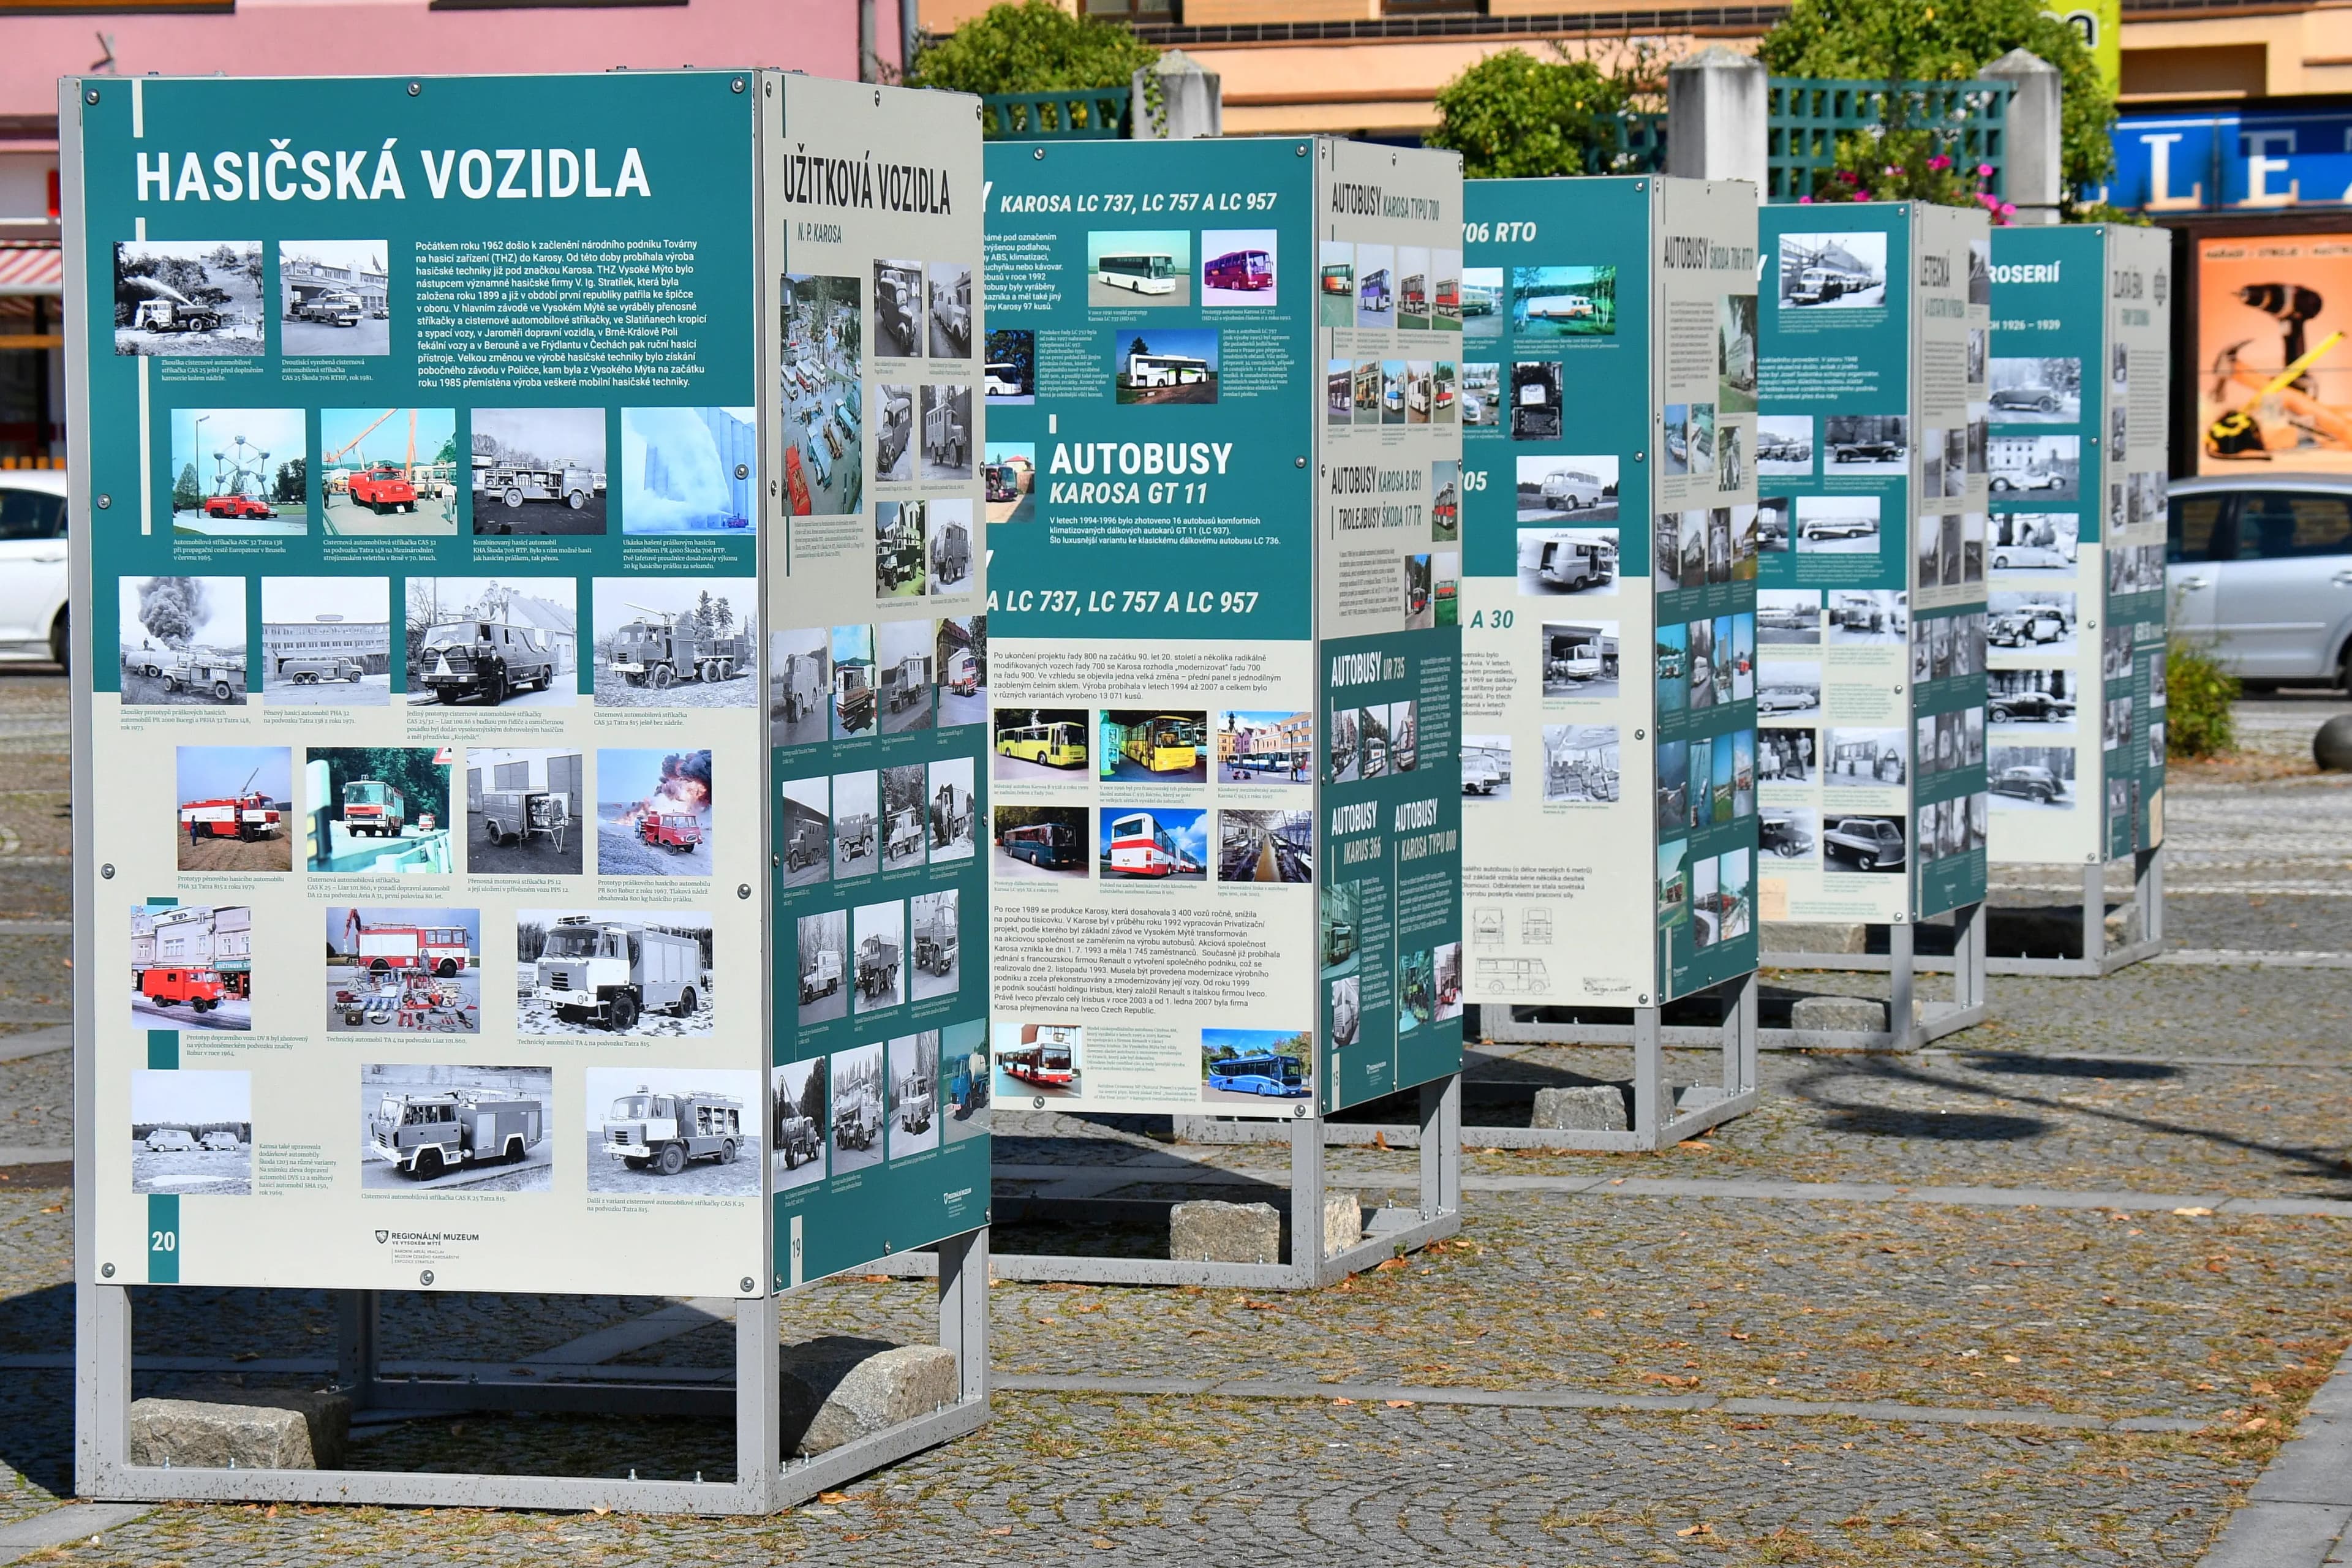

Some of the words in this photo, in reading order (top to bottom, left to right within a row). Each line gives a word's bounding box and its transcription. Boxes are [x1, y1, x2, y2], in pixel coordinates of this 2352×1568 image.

[137, 138, 406, 201] HASIČSKÁ
[420, 148, 651, 199] VOZIDLA
[783, 143, 873, 209] UŽITKOVÁ
[877, 163, 951, 215] VOZIDLA
[1000, 195, 1071, 213] KAROSA
[1077, 194, 1099, 212] LC
[1103, 194, 1137, 215] 737,
[1142, 194, 1164, 211] LC
[1169, 193, 1199, 211] 757
[1202, 193, 1215, 211] A
[1219, 192, 1242, 211] LC
[1246, 192, 1277, 210] 957
[1332, 182, 1382, 216] AUTOBUSY
[1382, 195, 1409, 219] KAROSA
[1411, 197, 1428, 221] TYPU
[1428, 199, 1439, 221] 700
[797, 222, 805, 241] N.
[807, 222, 812, 242] P.
[813, 223, 842, 244] KAROSA
[1463, 222, 1489, 243] 06
[1494, 221, 1537, 242] RTO
[415, 241, 459, 251] Počátkem
[461, 241, 480, 251] roku
[482, 241, 504, 250] 1962
[505, 240, 530, 250] došlo
[531, 240, 537, 250] k
[538, 239, 580, 250] začlenění
[581, 239, 625, 249] národního
[627, 239, 662, 251] podniku
[663, 239, 698, 251] Továrny
[1664, 236, 1708, 270] AUTOBUSY
[428, 254, 454, 263] hasicí
[456, 253, 490, 263] zařízení
[491, 252, 518, 265] (THZ)
[519, 253, 531, 262] do
[533, 253, 564, 264] Karosy.
[566, 252, 579, 262] Od
[580, 252, 598, 262] této
[600, 252, 621, 263] doby
[623, 251, 663, 263] probíhala
[665, 251, 695, 263] výroba
[416, 266, 454, 276] hasičské
[455, 266, 492, 277] techniky
[493, 265, 503, 277] již
[505, 265, 522, 277] pod
[524, 265, 560, 275] značkou
[562, 265, 595, 274] Karosa.
[597, 265, 617, 274] THZ
[618, 264, 650, 276] Vysoké
[652, 264, 674, 276] Mýto
[675, 264, 694, 276] bylo
[418, 378, 437, 387] roku
[439, 378, 461, 387] 1985
[463, 377, 511, 389] přemístěna
[513, 377, 542, 389] výroba
[543, 377, 577, 386] veškeré
[579, 377, 611, 386] mobilní
[612, 377, 650, 386] hasičské
[652, 377, 690, 388] techniky.
[1049, 442, 1233, 475] AUTOBUSY
[1331, 466, 1377, 495] AUTOBUSY
[1378, 470, 1404, 492] KAROSA
[1405, 470, 1410, 491] B
[1411, 470, 1422, 491] 831
[1049, 482, 1140, 504] KAROSA
[1148, 482, 1179, 504] GT
[1185, 483, 1207, 504] 11
[1118, 516, 1133, 526] bylo
[1217, 516, 1261, 525] komfortních
[1339, 507, 1381, 530] TROLEJBUSY
[1381, 501, 1403, 528] ŠKODA
[1405, 505, 1412, 526] 17
[1414, 504, 1422, 526] TR
[1049, 526, 1106, 536] klimatizovaných
[1106, 525, 1142, 536] dálkových
[1143, 526, 1175, 535] autokarů
[1199, 526, 1212, 536] (LC
[1213, 527, 1231, 536] 937).
[1006, 590, 1033, 612] LC
[1039, 590, 1081, 616] 737,
[1088, 590, 1116, 612] LC
[1121, 591, 1161, 612] 757
[1163, 591, 1179, 612] A
[1186, 591, 1214, 613] LC
[1220, 591, 1259, 613] 957
[1469, 610, 1483, 628] A
[1490, 609, 1513, 628] 30
[1331, 651, 1382, 688] AUTOBUSY
[1383, 658, 1393, 680] UR
[1393, 656, 1405, 679] 735
[999, 690, 1027, 699] různých
[1066, 692, 1098, 701] vyrobeno
[1331, 800, 1378, 837] AUTOBUSY
[1395, 797, 1438, 832] AUTOBUSY
[1343, 838, 1369, 865] IKARUS
[1369, 835, 1381, 859] 366
[1401, 835, 1427, 862] KAROSA
[1428, 831, 1446, 856] TYPU
[1446, 829, 1457, 852] 800
[1020, 1003, 1069, 1013] přejmenována
[1124, 1006, 1156, 1015] Republic.
[1332, 1071, 1339, 1087] 15
[151, 1231, 176, 1251] 20
[391, 1231, 442, 1240] REGIONÁLNÍ
[792, 1238, 801, 1258] 19
